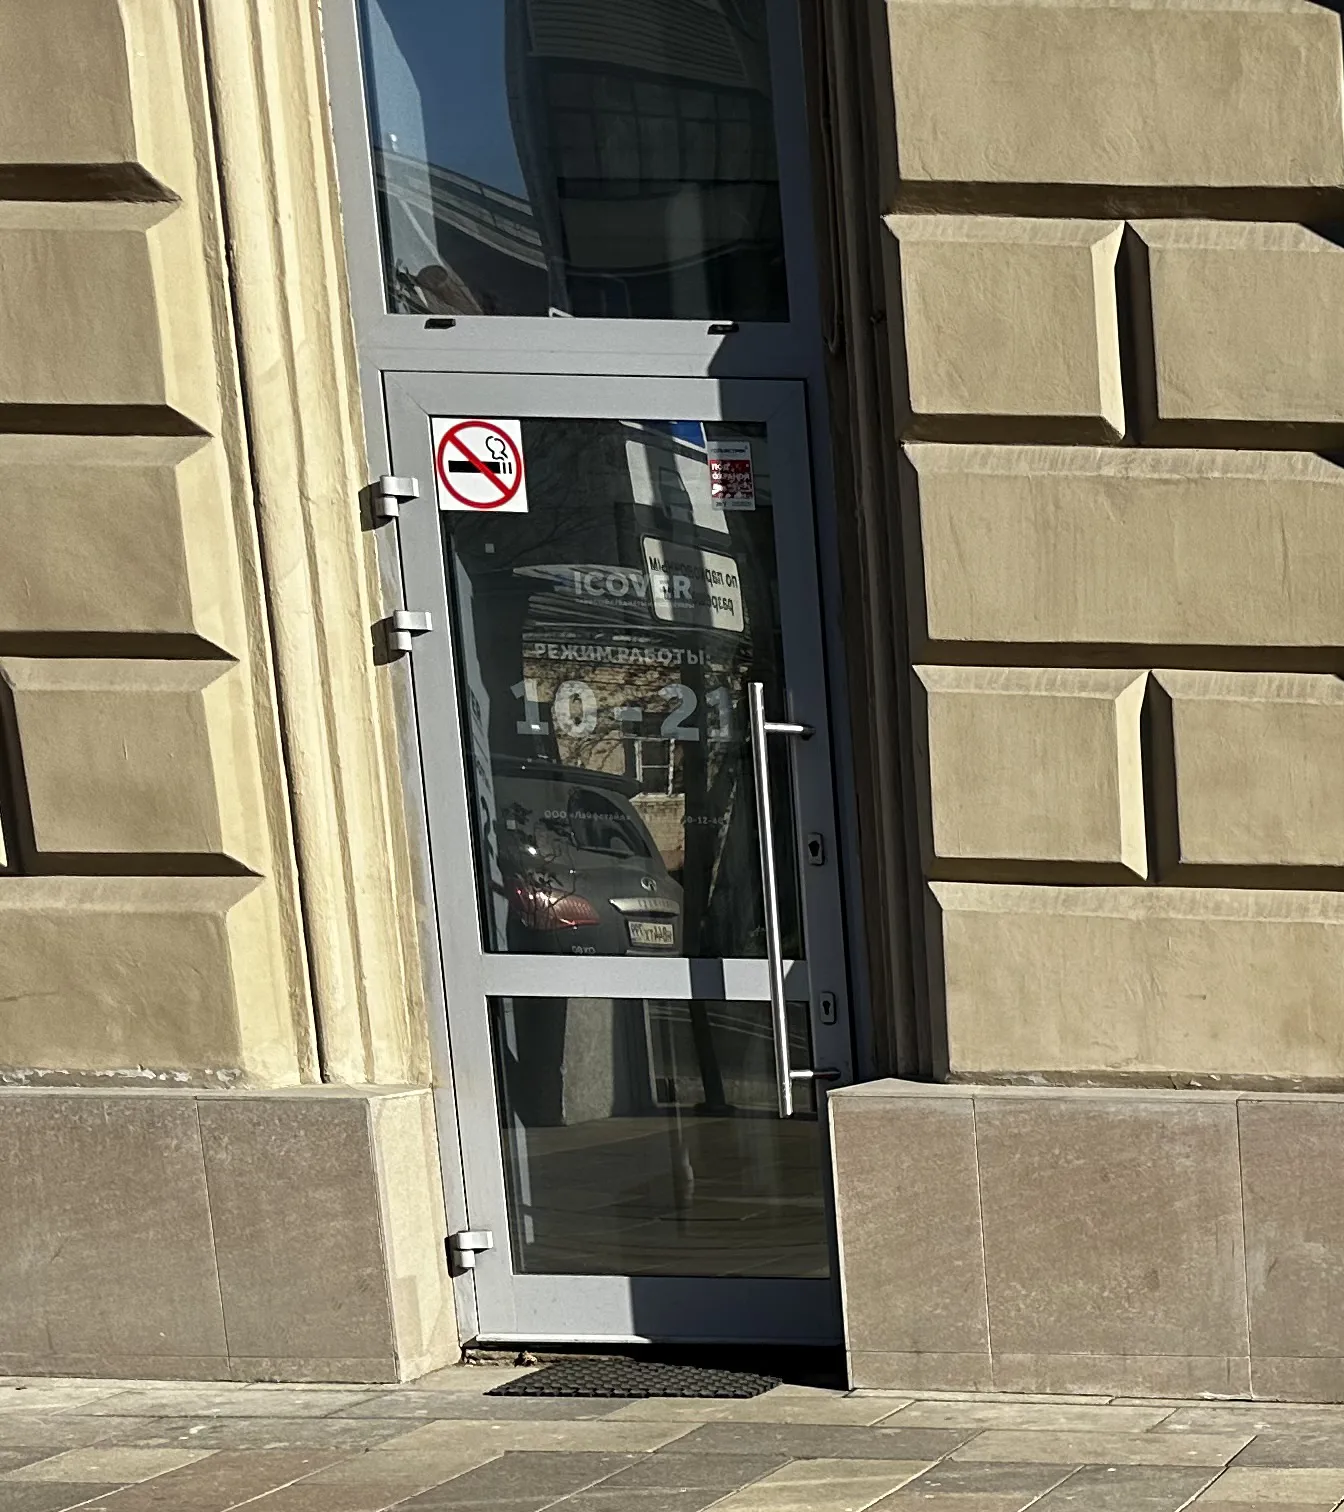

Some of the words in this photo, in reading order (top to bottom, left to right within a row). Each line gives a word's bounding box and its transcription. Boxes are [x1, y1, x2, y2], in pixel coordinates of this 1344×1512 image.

[573, 571, 693, 600] ICOVER
[533, 643, 613, 663] РЕЖИМ
[614, 646, 712, 666] РАБОТЫ:
[510, 678, 598, 738] 10
[660, 683, 742, 742] 21
